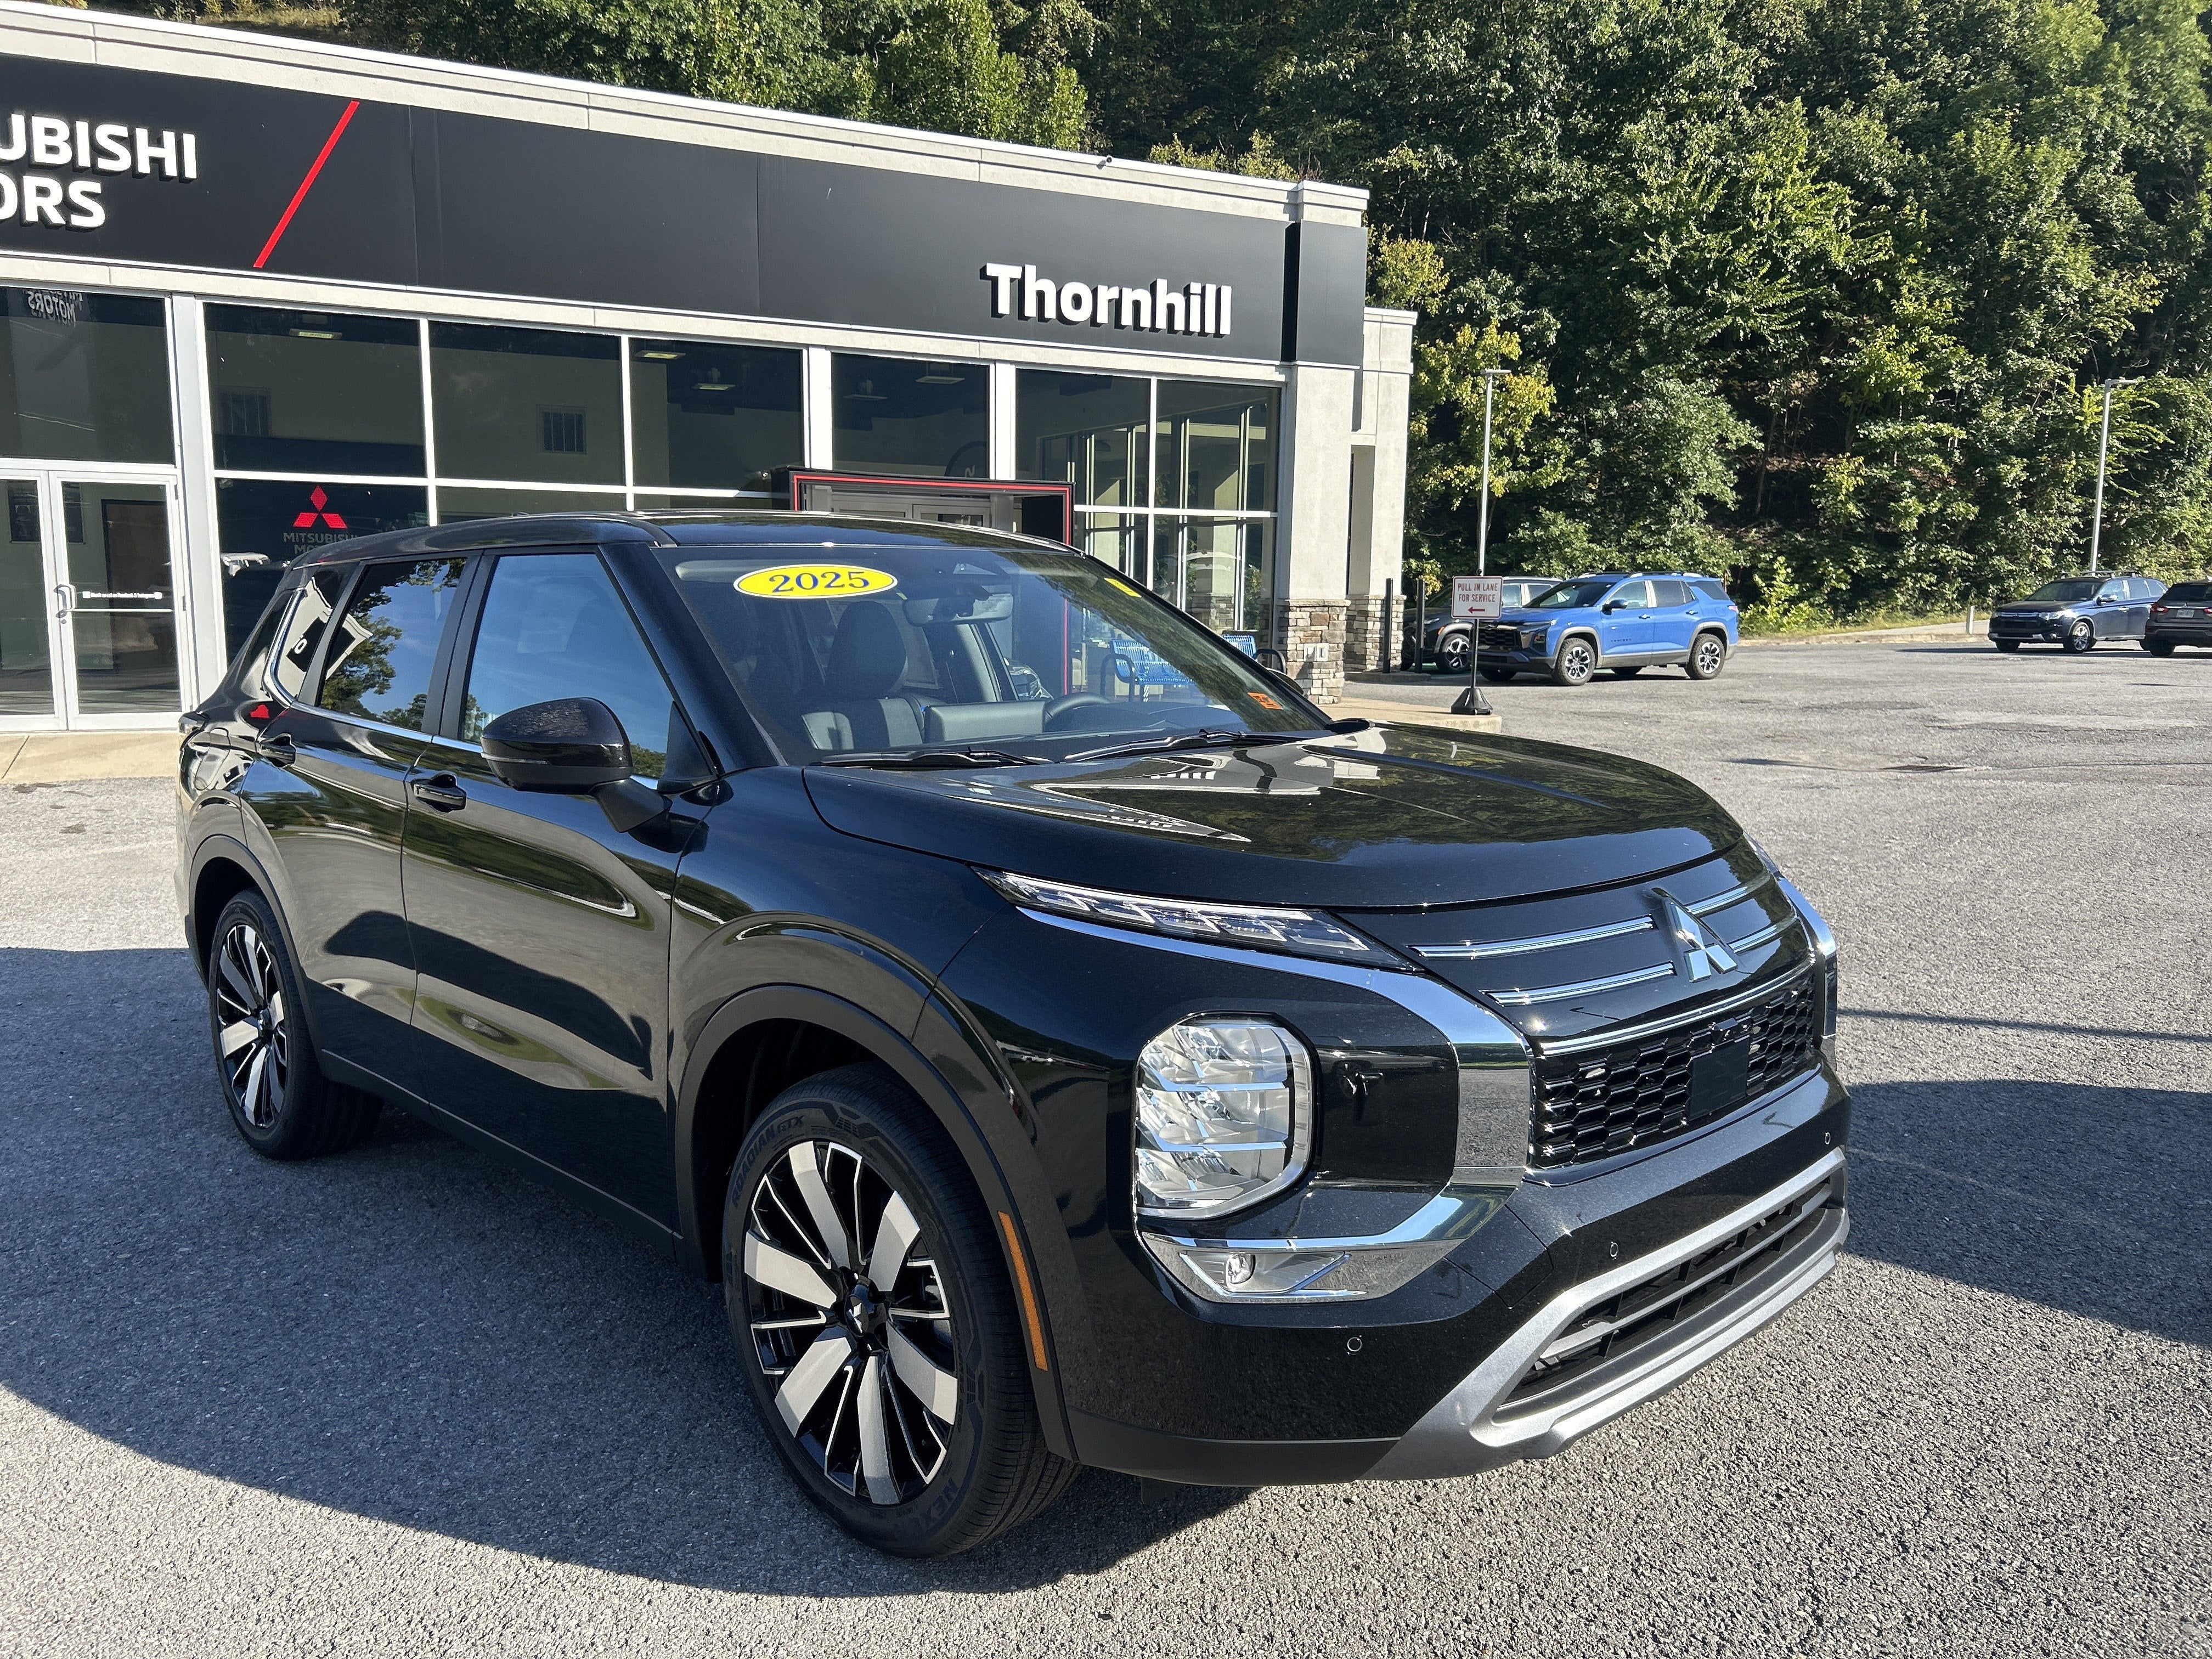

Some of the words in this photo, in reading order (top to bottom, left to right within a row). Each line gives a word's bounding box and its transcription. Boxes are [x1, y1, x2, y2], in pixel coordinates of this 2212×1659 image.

[986, 262, 1232, 335] Thornhill
[769, 571, 870, 593] 2025
[1458, 583, 1471, 591] PULL
[1474, 583, 1480, 591] IN
[1483, 583, 1498, 591] LANE
[1459, 594, 1469, 602] FOR
[1471, 594, 1496, 602] SERVICE
[731, 1124, 776, 1208] ROADIAN
[777, 1115, 805, 1135] GTX
